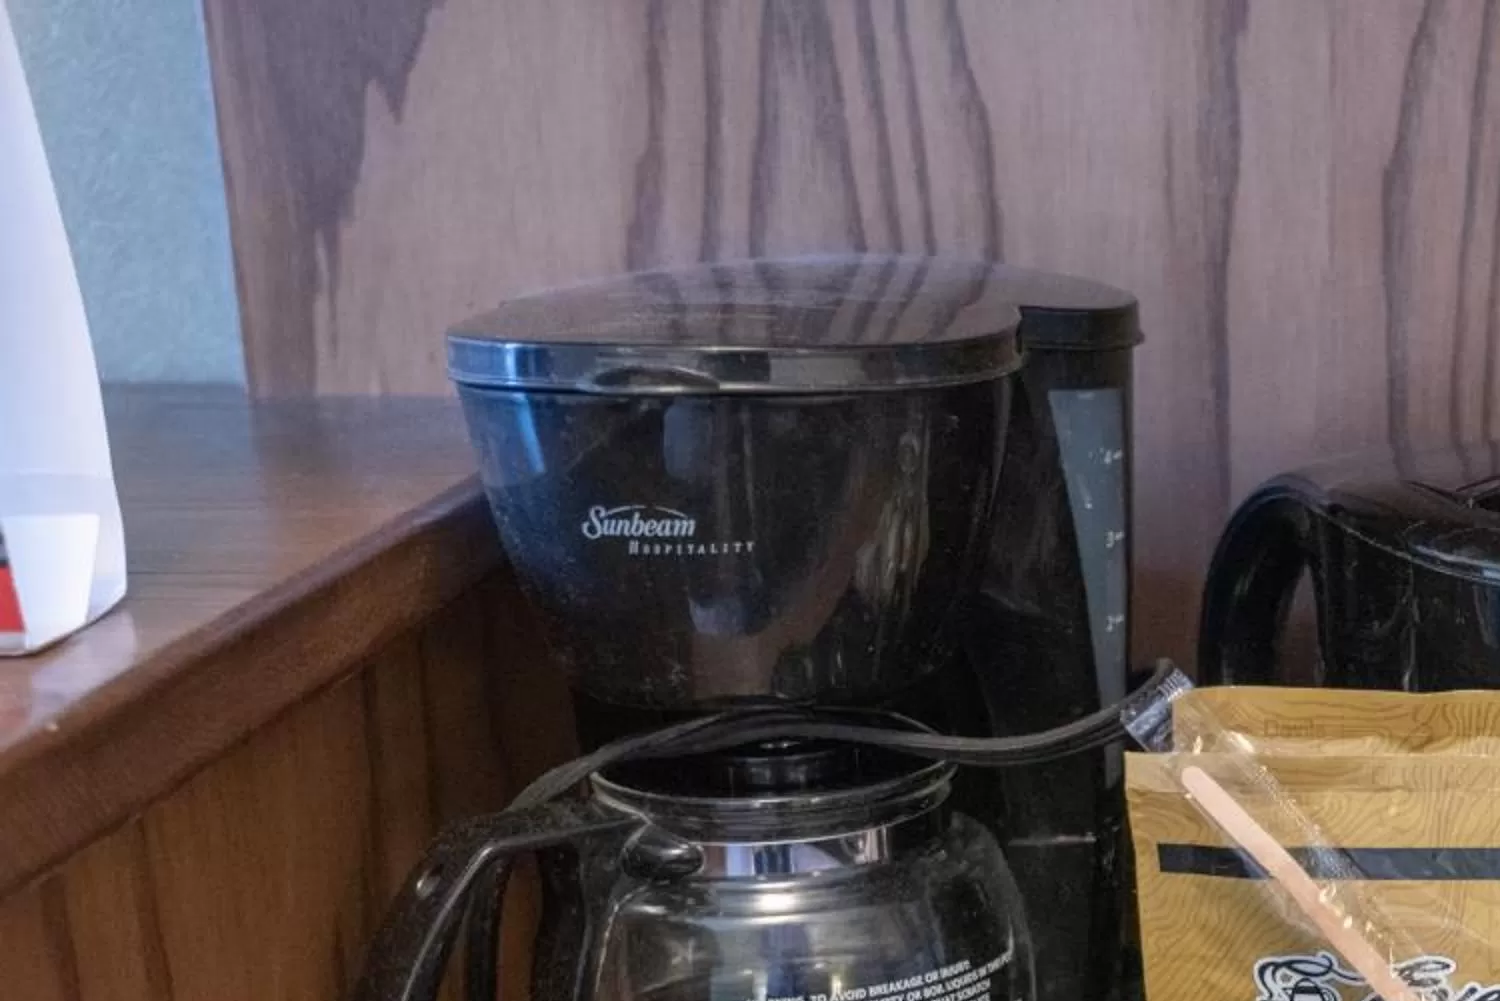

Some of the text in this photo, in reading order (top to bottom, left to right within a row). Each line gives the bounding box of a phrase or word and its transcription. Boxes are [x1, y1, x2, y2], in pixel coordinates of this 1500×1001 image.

[582, 505, 697, 540] Sunbeam
[628, 540, 755, 555] HOSPITALITY
[869, 975, 923, 995] BREAKAGE
